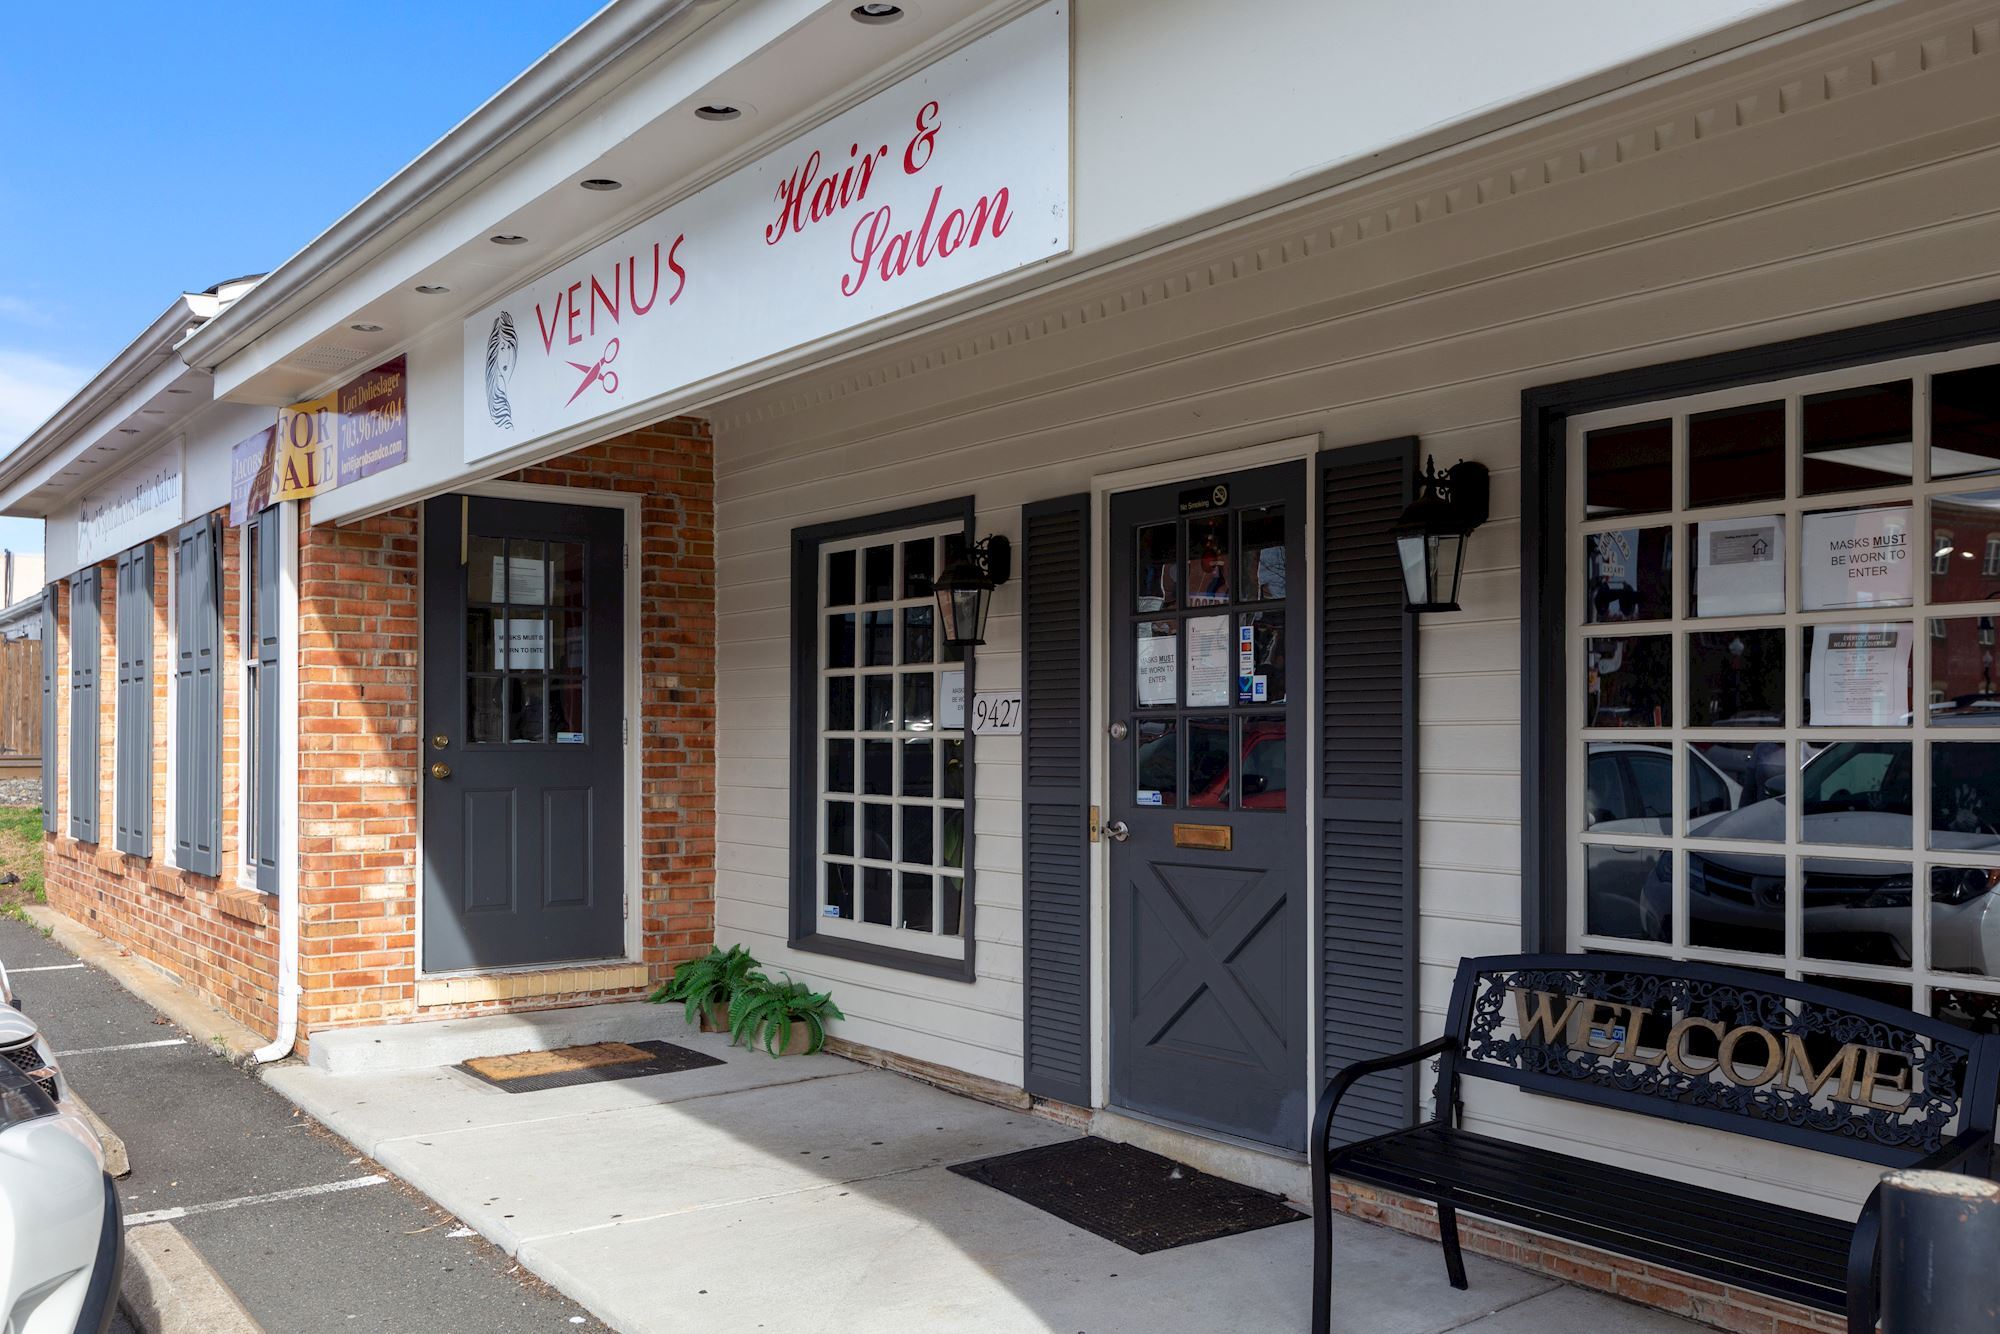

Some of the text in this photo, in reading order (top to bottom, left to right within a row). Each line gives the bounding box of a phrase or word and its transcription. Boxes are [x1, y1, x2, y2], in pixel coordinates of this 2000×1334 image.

[766, 100, 942, 246] Hair &
[841, 185, 1014, 297] Salon
[535, 233, 686, 357] VENUS
[343, 388, 357, 414] Lori
[277, 406, 330, 453] FOR
[341, 397, 402, 451] 703.967.6694
[234, 451, 261, 482] JACOBS
[271, 445, 334, 496] SALE
[155, 467, 177, 508] Salon
[1830, 534, 1906, 551] MASKS MUST
[1831, 549, 1906, 566] BE WORN TO
[1848, 566, 1888, 578] ENTER
[1159, 654, 1174, 663] MUST
[976, 698, 1021, 731] 9427
[1506, 986, 1913, 1115] WELCOME
